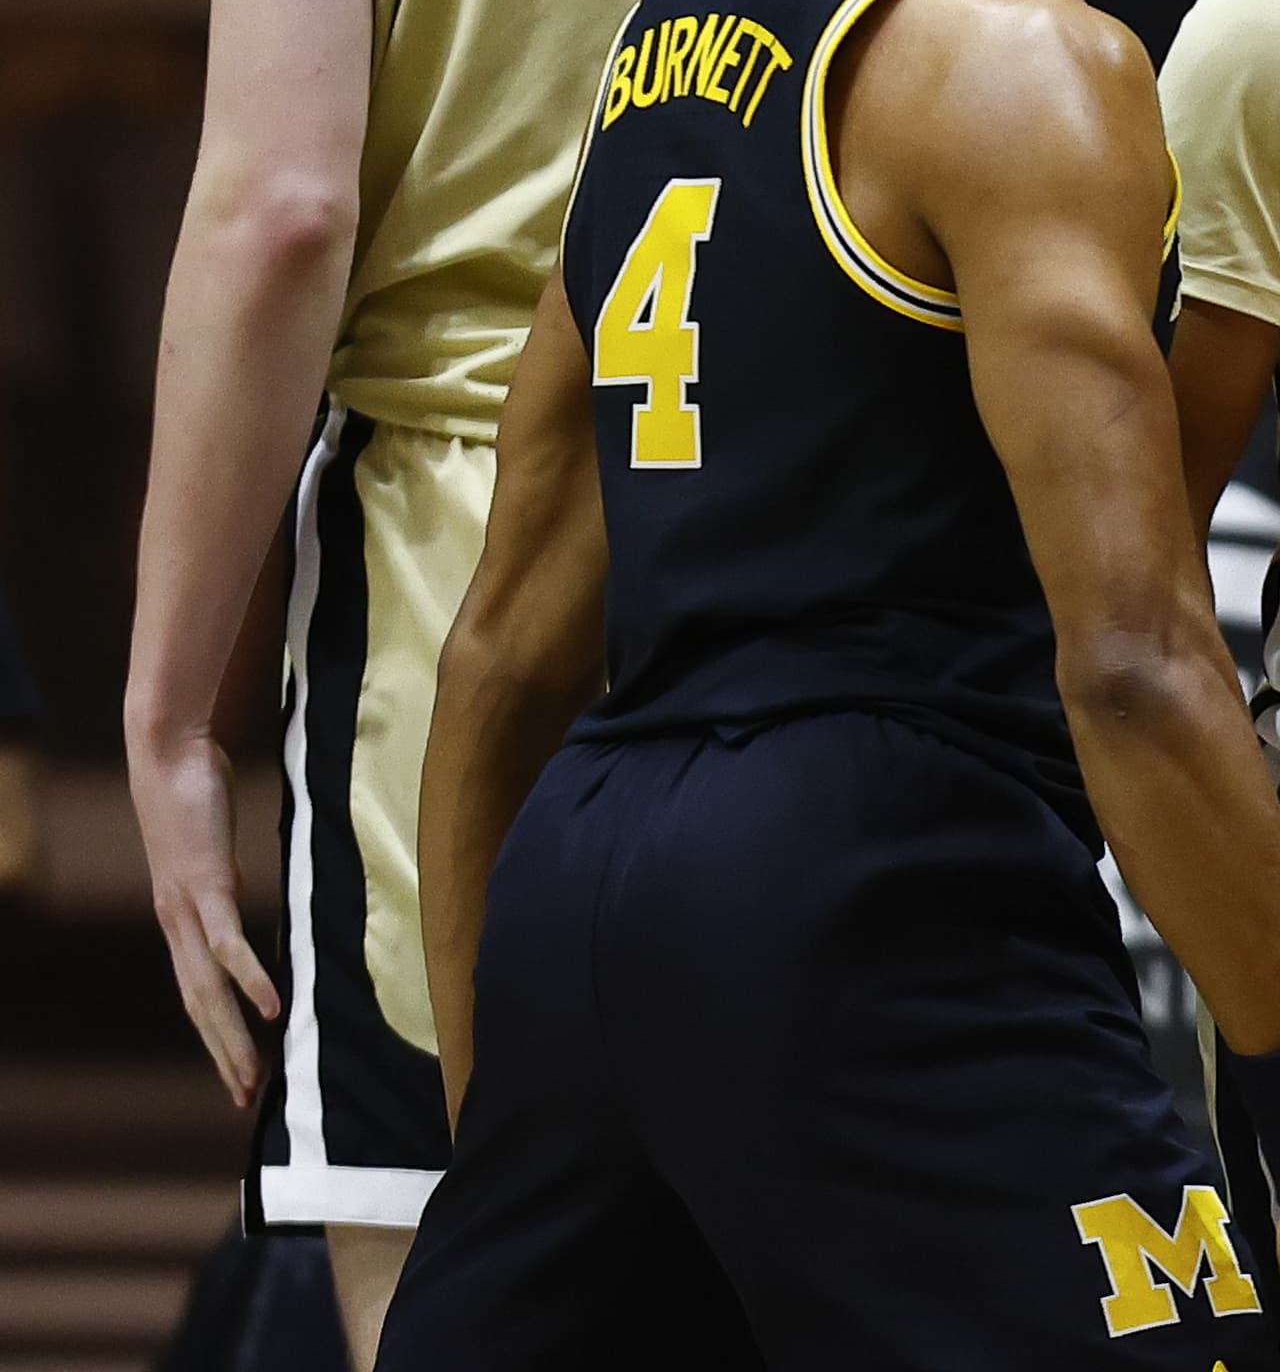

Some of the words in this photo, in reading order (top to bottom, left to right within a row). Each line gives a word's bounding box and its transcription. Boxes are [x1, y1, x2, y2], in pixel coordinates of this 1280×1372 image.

[601, 13, 793, 131] BURNETT
[592, 177, 723, 469] 4
[1070, 1184, 1263, 1338] M
